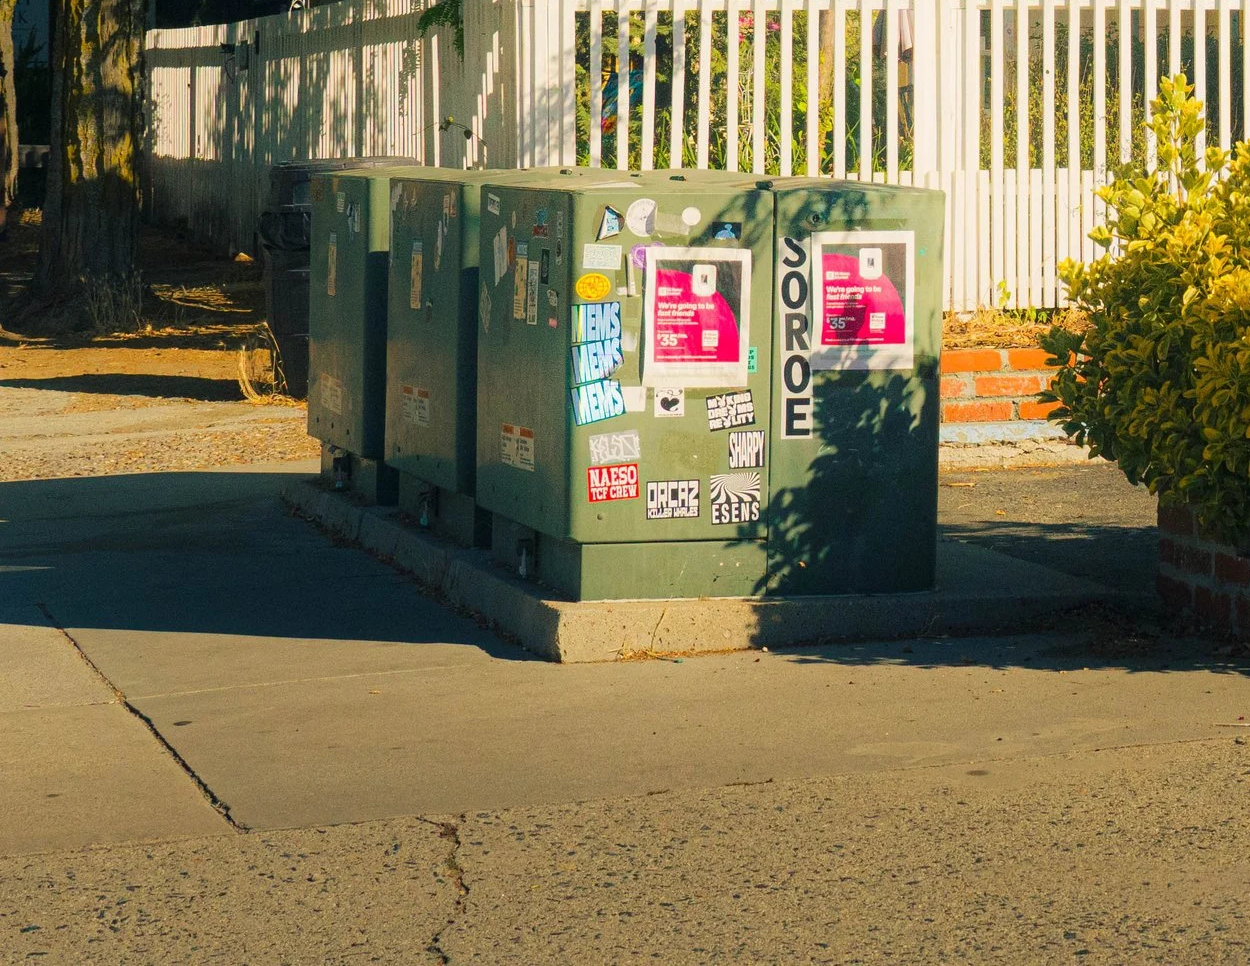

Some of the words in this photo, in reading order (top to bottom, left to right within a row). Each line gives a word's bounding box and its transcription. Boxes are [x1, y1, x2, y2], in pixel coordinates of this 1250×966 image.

[846, 286, 864, 294] going
[678, 302, 697, 311] going
[729, 431, 764, 468] SHARPY
[589, 465, 637, 487] NAESO
[590, 487, 608, 501] TCF
[610, 484, 637, 499] CREW
[647, 481, 699, 508] ORCAZ
[648, 507, 673, 519] KILLER
[711, 501, 760, 524] ESENS
